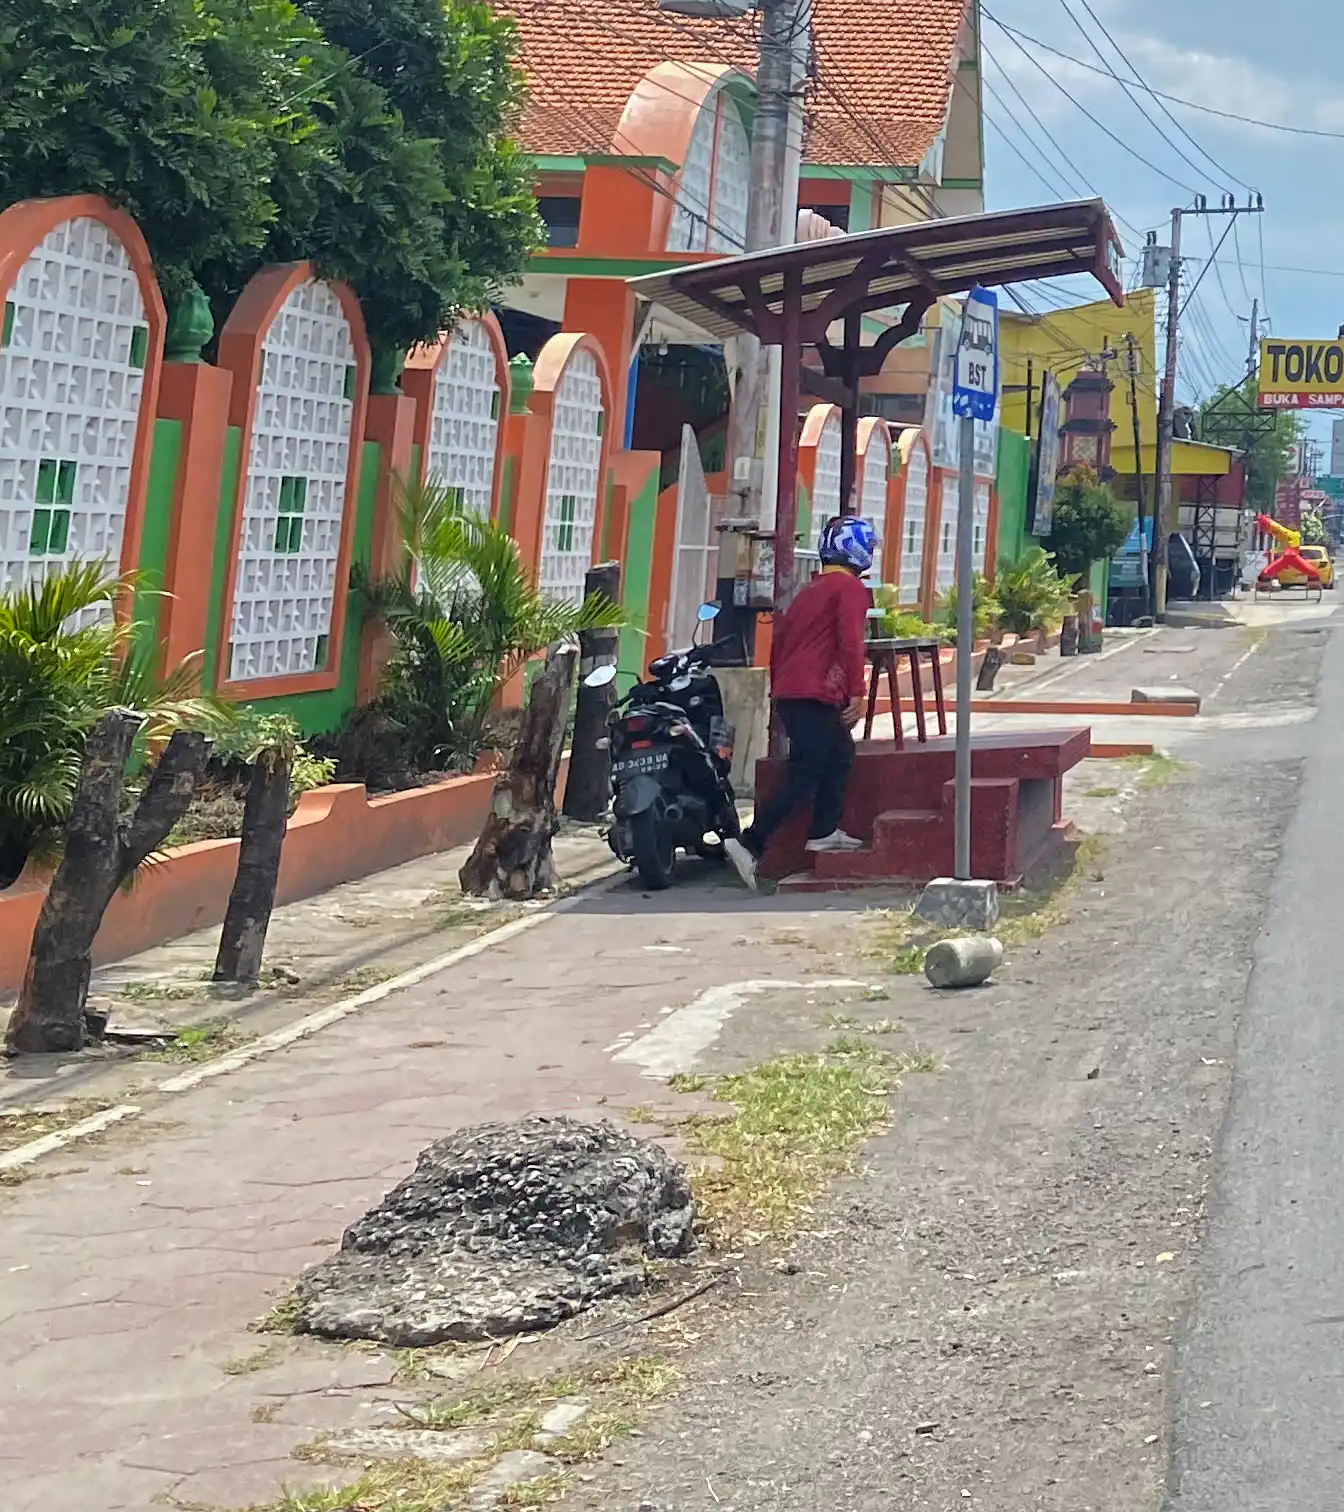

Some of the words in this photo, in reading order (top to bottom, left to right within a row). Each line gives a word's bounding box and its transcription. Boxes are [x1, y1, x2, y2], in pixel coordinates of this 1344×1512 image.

[968, 362, 987, 390] BST
[1267, 345, 1344, 383] TOKO
[1264, 394, 1299, 405] BUKA
